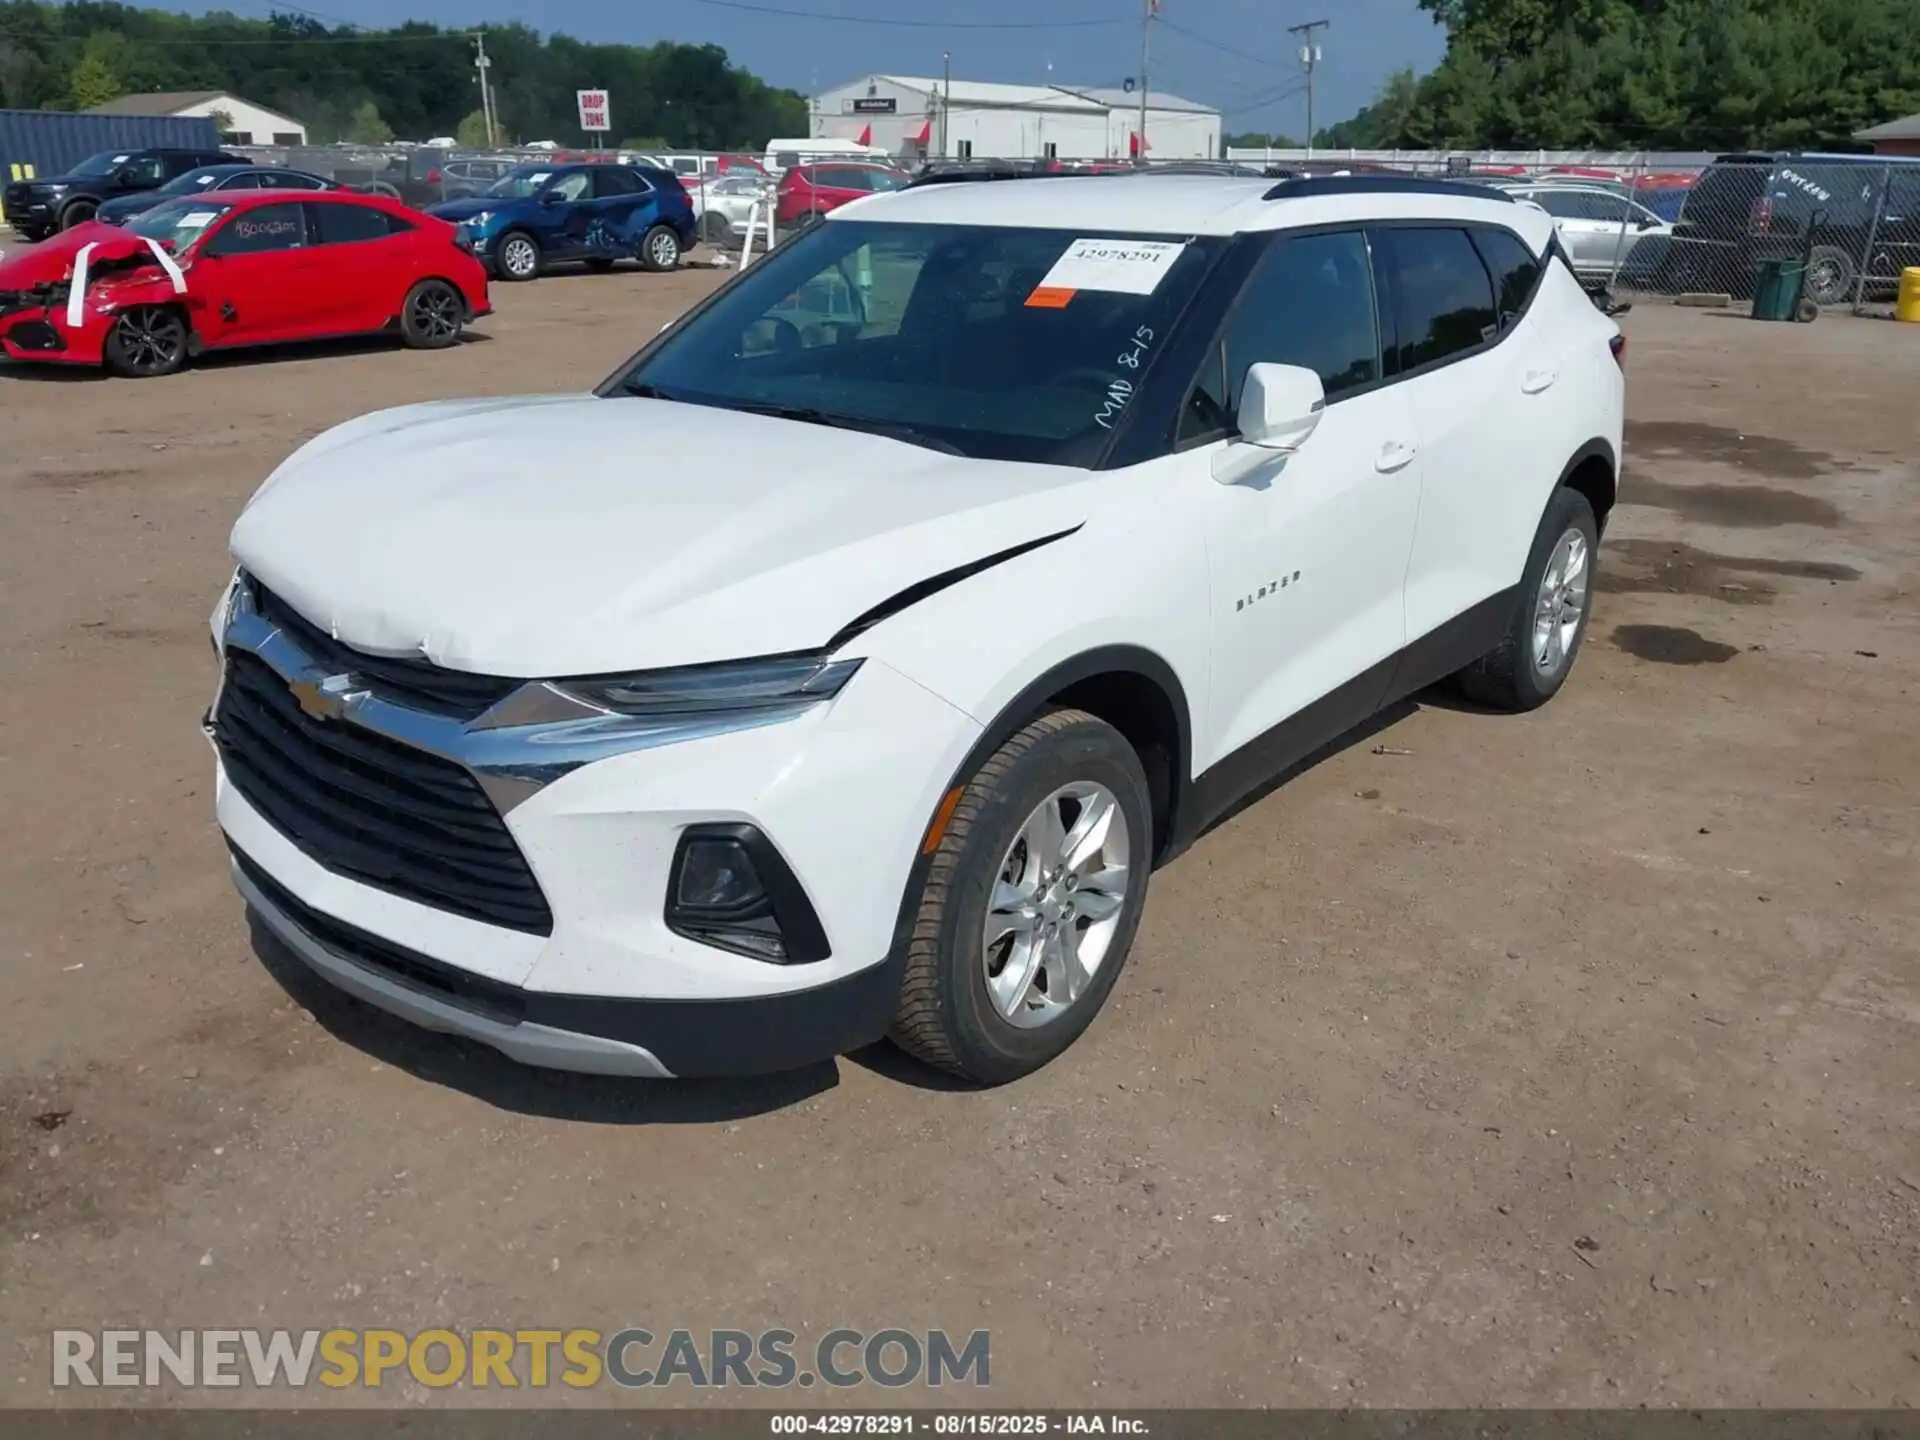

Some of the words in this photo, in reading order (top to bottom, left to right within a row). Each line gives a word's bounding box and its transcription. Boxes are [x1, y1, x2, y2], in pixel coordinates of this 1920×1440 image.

[582, 94, 605, 108] DROP
[584, 112, 605, 127] ZONE
[1075, 248, 1161, 263] 42978291
[1117, 324, 1154, 368] 8-15
[1236, 569, 1301, 612] BLAZER
